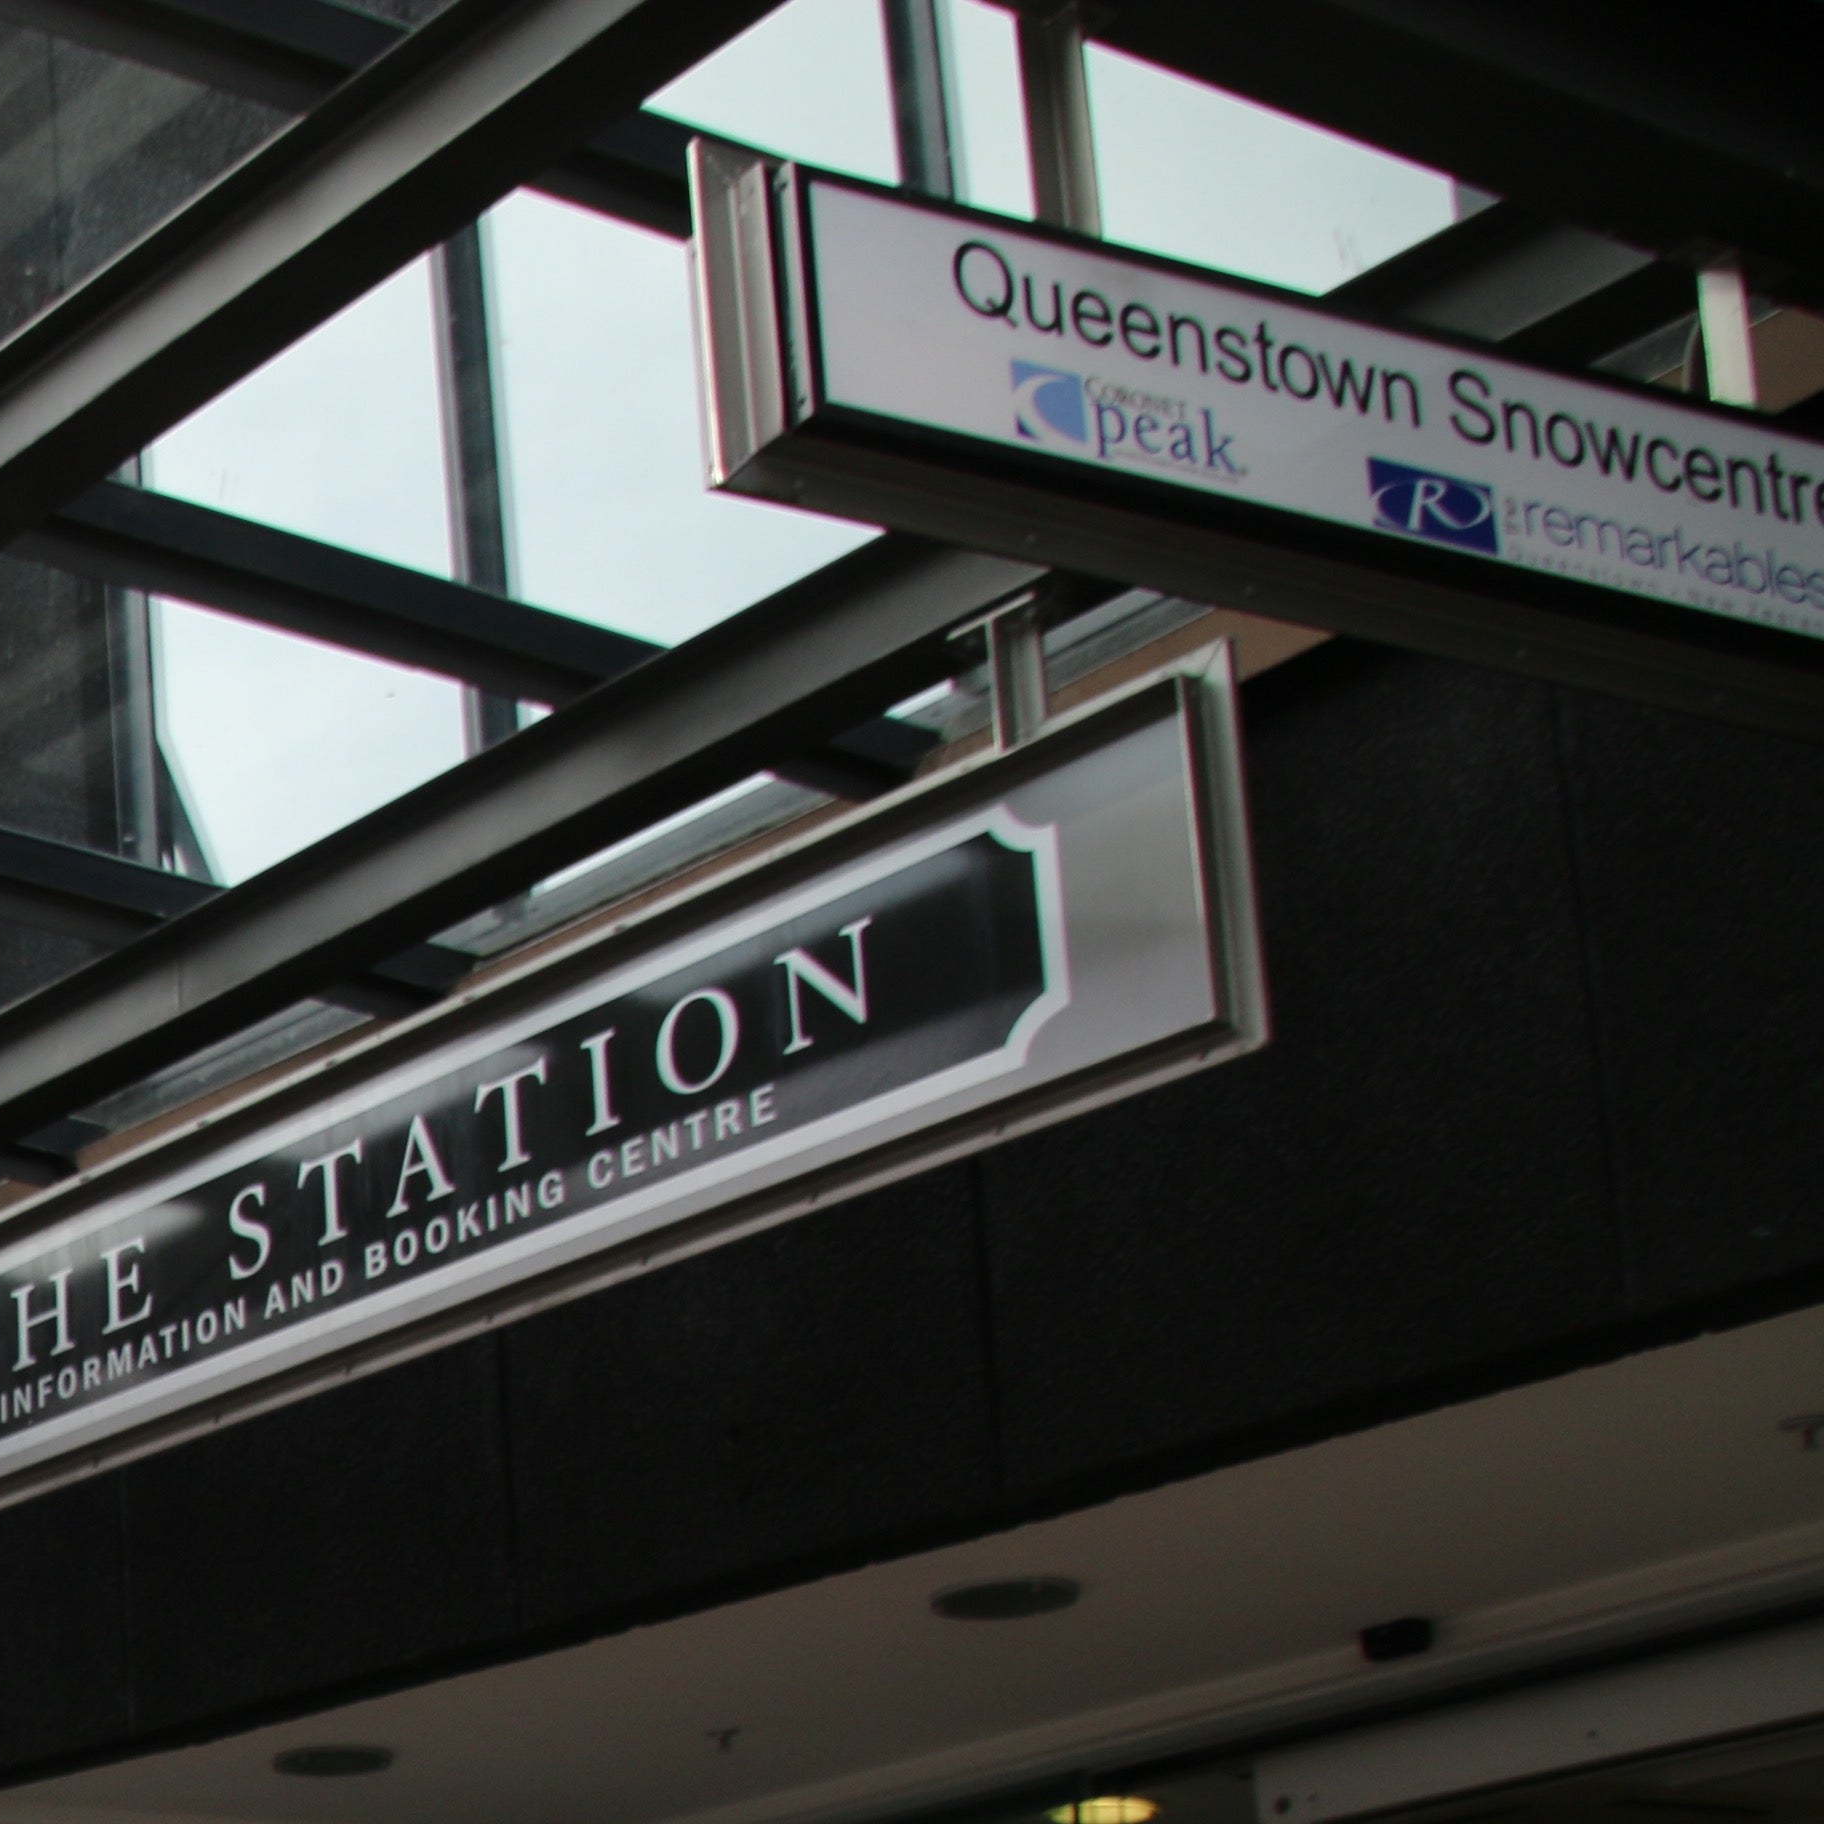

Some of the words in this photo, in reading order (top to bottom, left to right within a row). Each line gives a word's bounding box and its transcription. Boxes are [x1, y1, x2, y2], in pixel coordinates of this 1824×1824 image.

[953, 239, 1422, 429] Queenstown
[0, 1297, 247, 1424] INFORMATION
[263, 1259, 346, 1320] AND
[363, 1171, 566, 1280] BOOKING
[586, 1084, 778, 1191] CENTRE
[227, 916, 872, 1281] STATION
